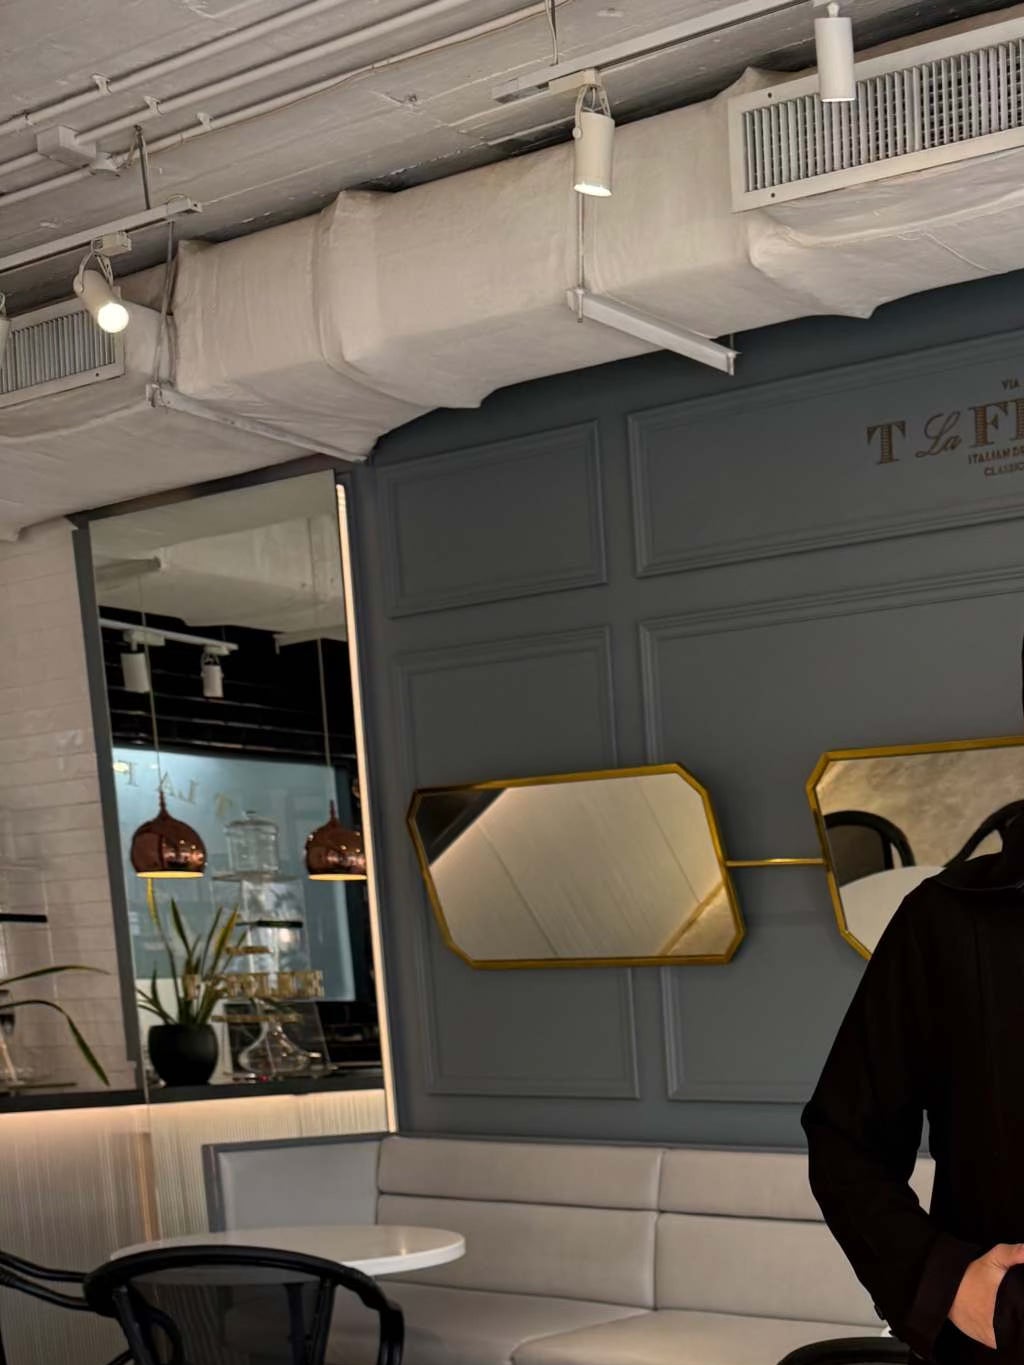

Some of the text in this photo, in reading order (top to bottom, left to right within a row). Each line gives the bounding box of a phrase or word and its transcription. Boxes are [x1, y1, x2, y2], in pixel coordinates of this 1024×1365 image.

[1001, 375, 1020, 389] VIA
[915, 411, 962, 459] La
[968, 446, 1011, 465] ITALIAN
